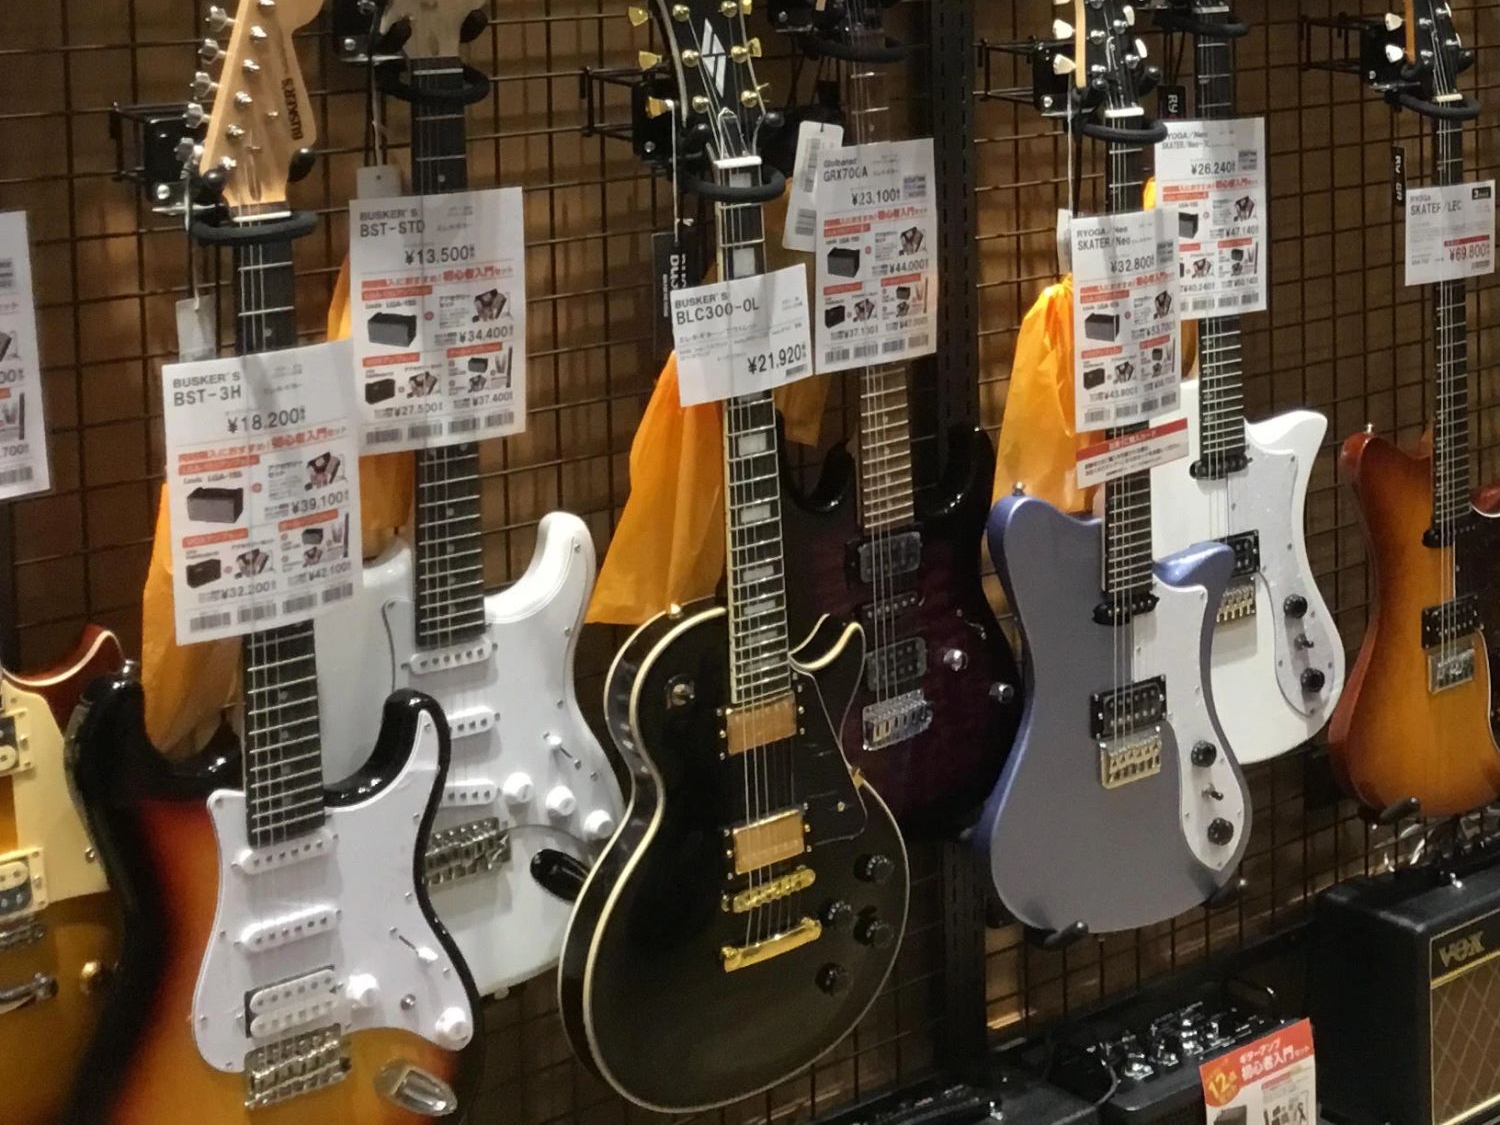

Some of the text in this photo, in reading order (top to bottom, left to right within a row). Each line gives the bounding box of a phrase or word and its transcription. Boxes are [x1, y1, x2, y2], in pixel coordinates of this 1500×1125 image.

[360, 220, 426, 238] BST-STD
[174, 385, 241, 406] BST-3H
[1439, 931, 1485, 967] VOX
